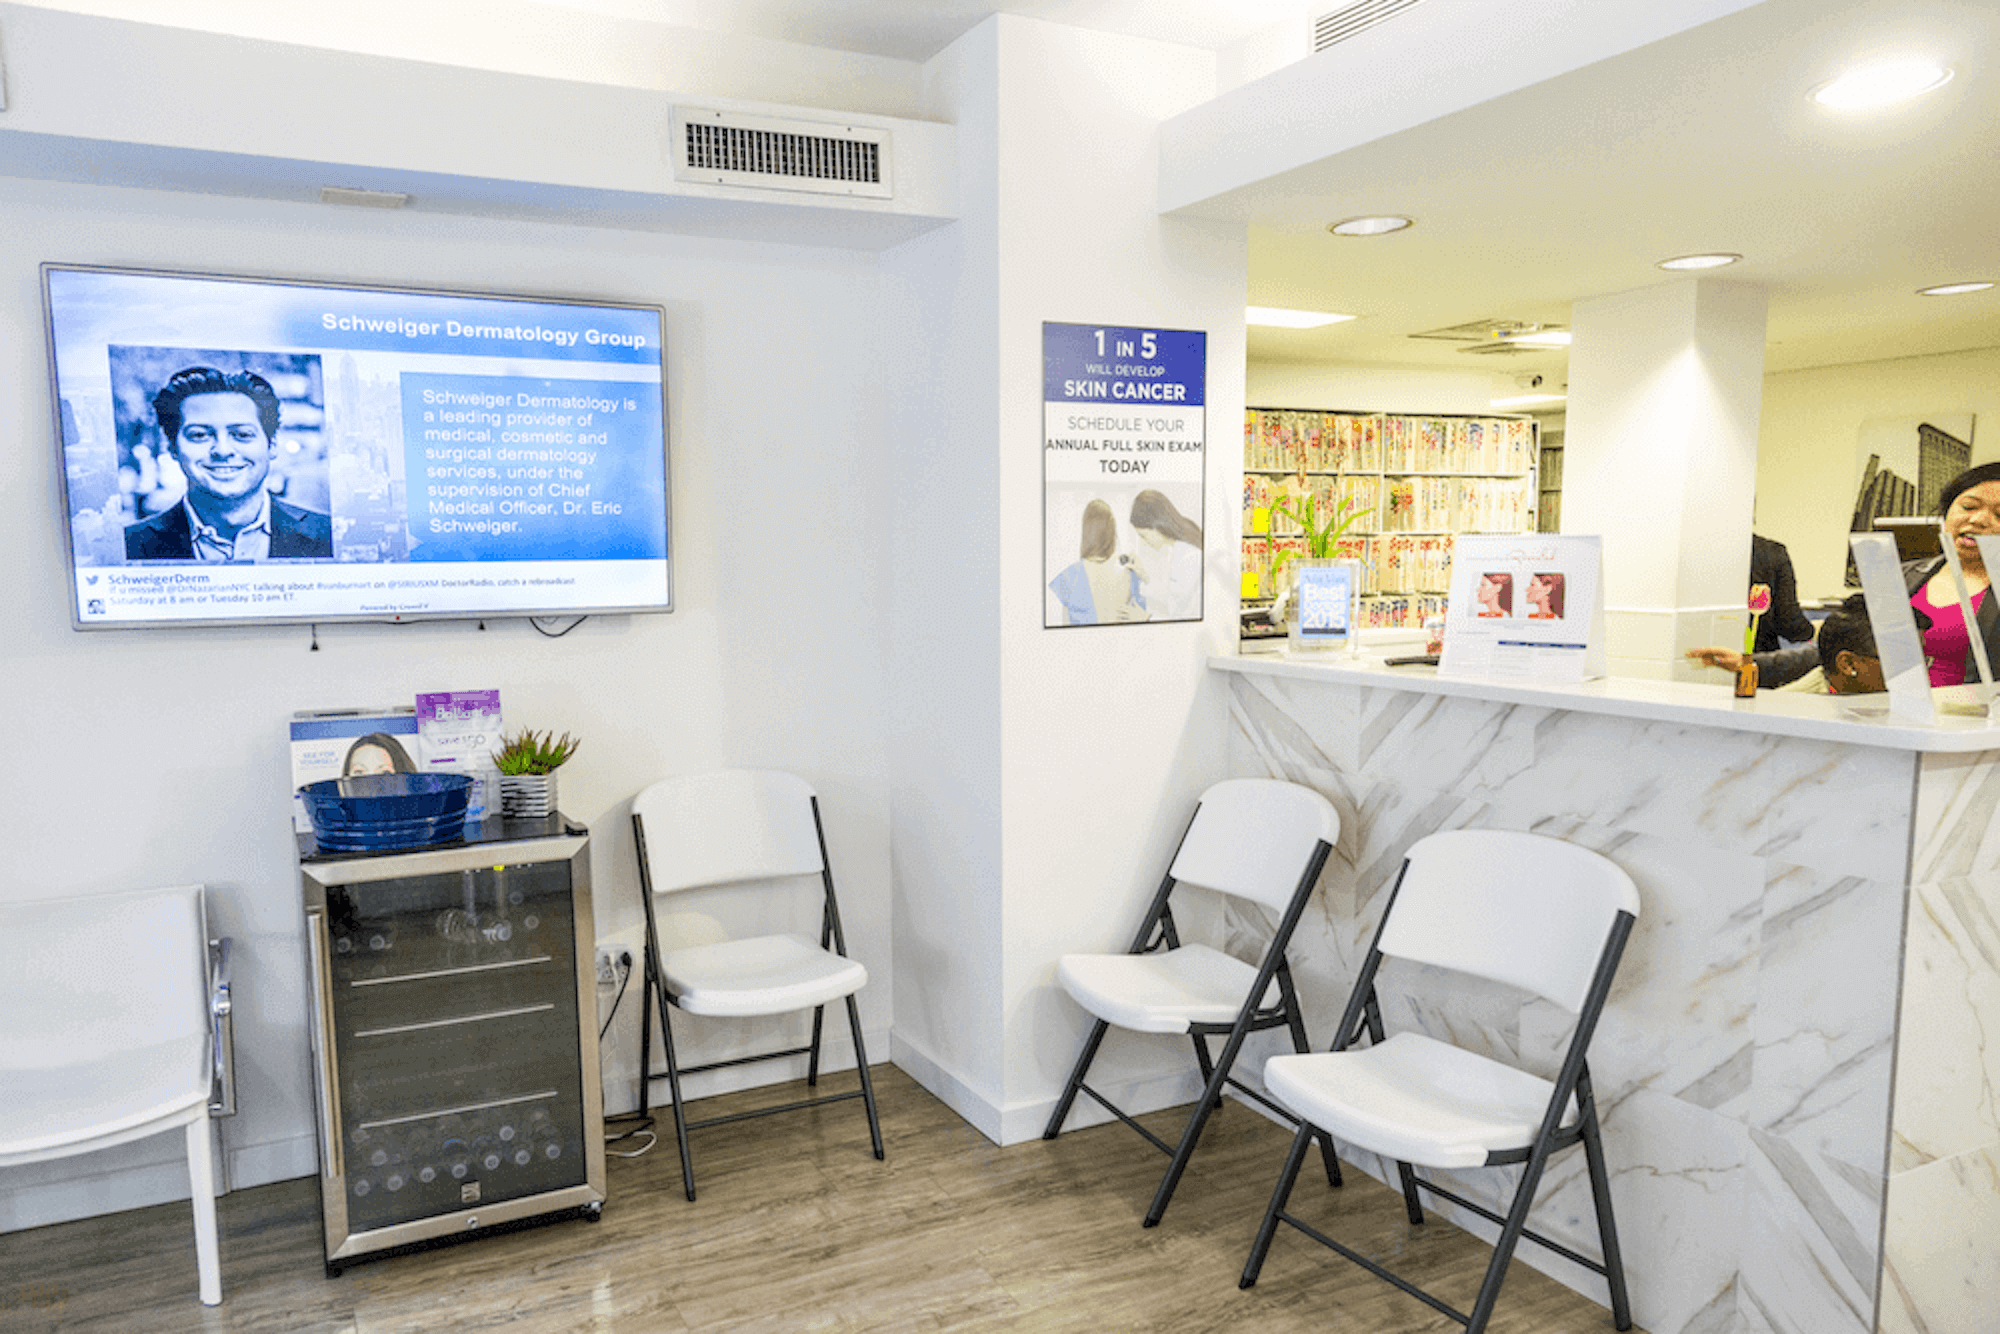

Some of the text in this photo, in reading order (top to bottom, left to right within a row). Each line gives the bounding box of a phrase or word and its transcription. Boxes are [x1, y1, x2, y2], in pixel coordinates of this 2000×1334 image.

[322, 313, 646, 350] Schweiger Dermatology Group
[1095, 330, 1157, 359] 1 IN 5
[1085, 363, 1166, 377] WILL DEVELOP
[1064, 380, 1186, 401] SKIN CANCER
[423, 389, 636, 413] Schweiger Dermatology is
[424, 409, 593, 428] a leading provider of
[1068, 416, 1185, 432] SCHEDULE YOUR
[425, 428, 607, 445] medical, cosmetic and
[1046, 439, 1203, 453] ANNUAL FULL SKIN EXAM
[425, 446, 597, 465] surgical dermatology
[427, 466, 583, 480] services, under the
[1099, 459, 1150, 474] TODAY
[428, 483, 591, 498] supervision of Chief
[429, 501, 622, 516] Medical Officer, Dr. Eric
[429, 518, 523, 536] Schweiger.
[108, 574, 211, 586] SchweigerDerm
[288, 582, 314, 591] about
[1304, 583, 1345, 600] Best
